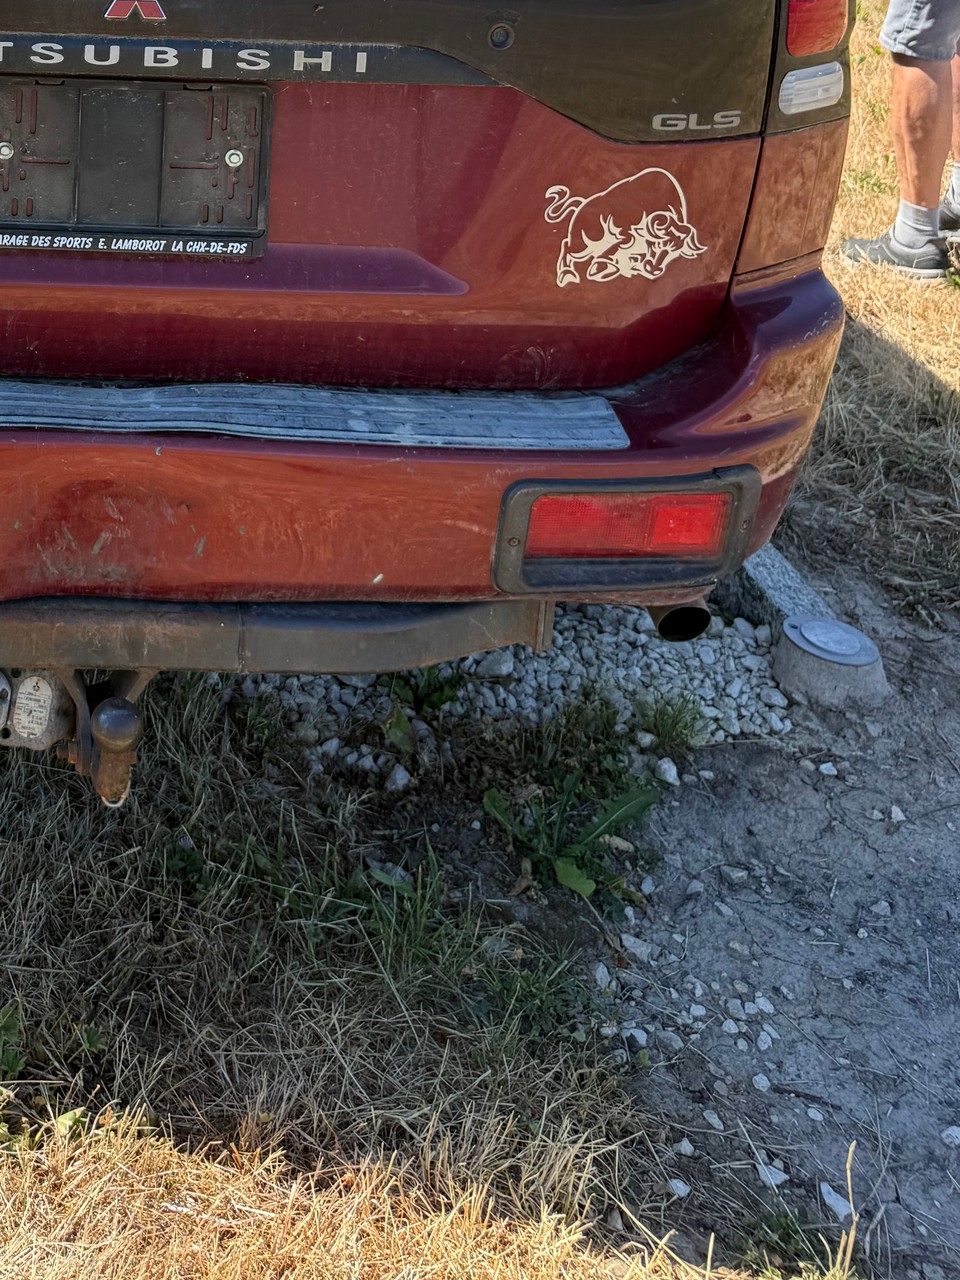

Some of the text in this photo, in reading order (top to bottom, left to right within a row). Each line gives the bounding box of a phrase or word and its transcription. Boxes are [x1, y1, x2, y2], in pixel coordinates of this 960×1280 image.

[652, 110, 742, 131] GLS
[31, 235, 52, 247] DES
[52, 236, 94, 249] SPORTS
[97, 238, 108, 249] E.
[110, 238, 167, 252] LAMBOROT
[171, 240, 184, 252] LA
[185, 241, 248, 255] CHX-DE-FDS
